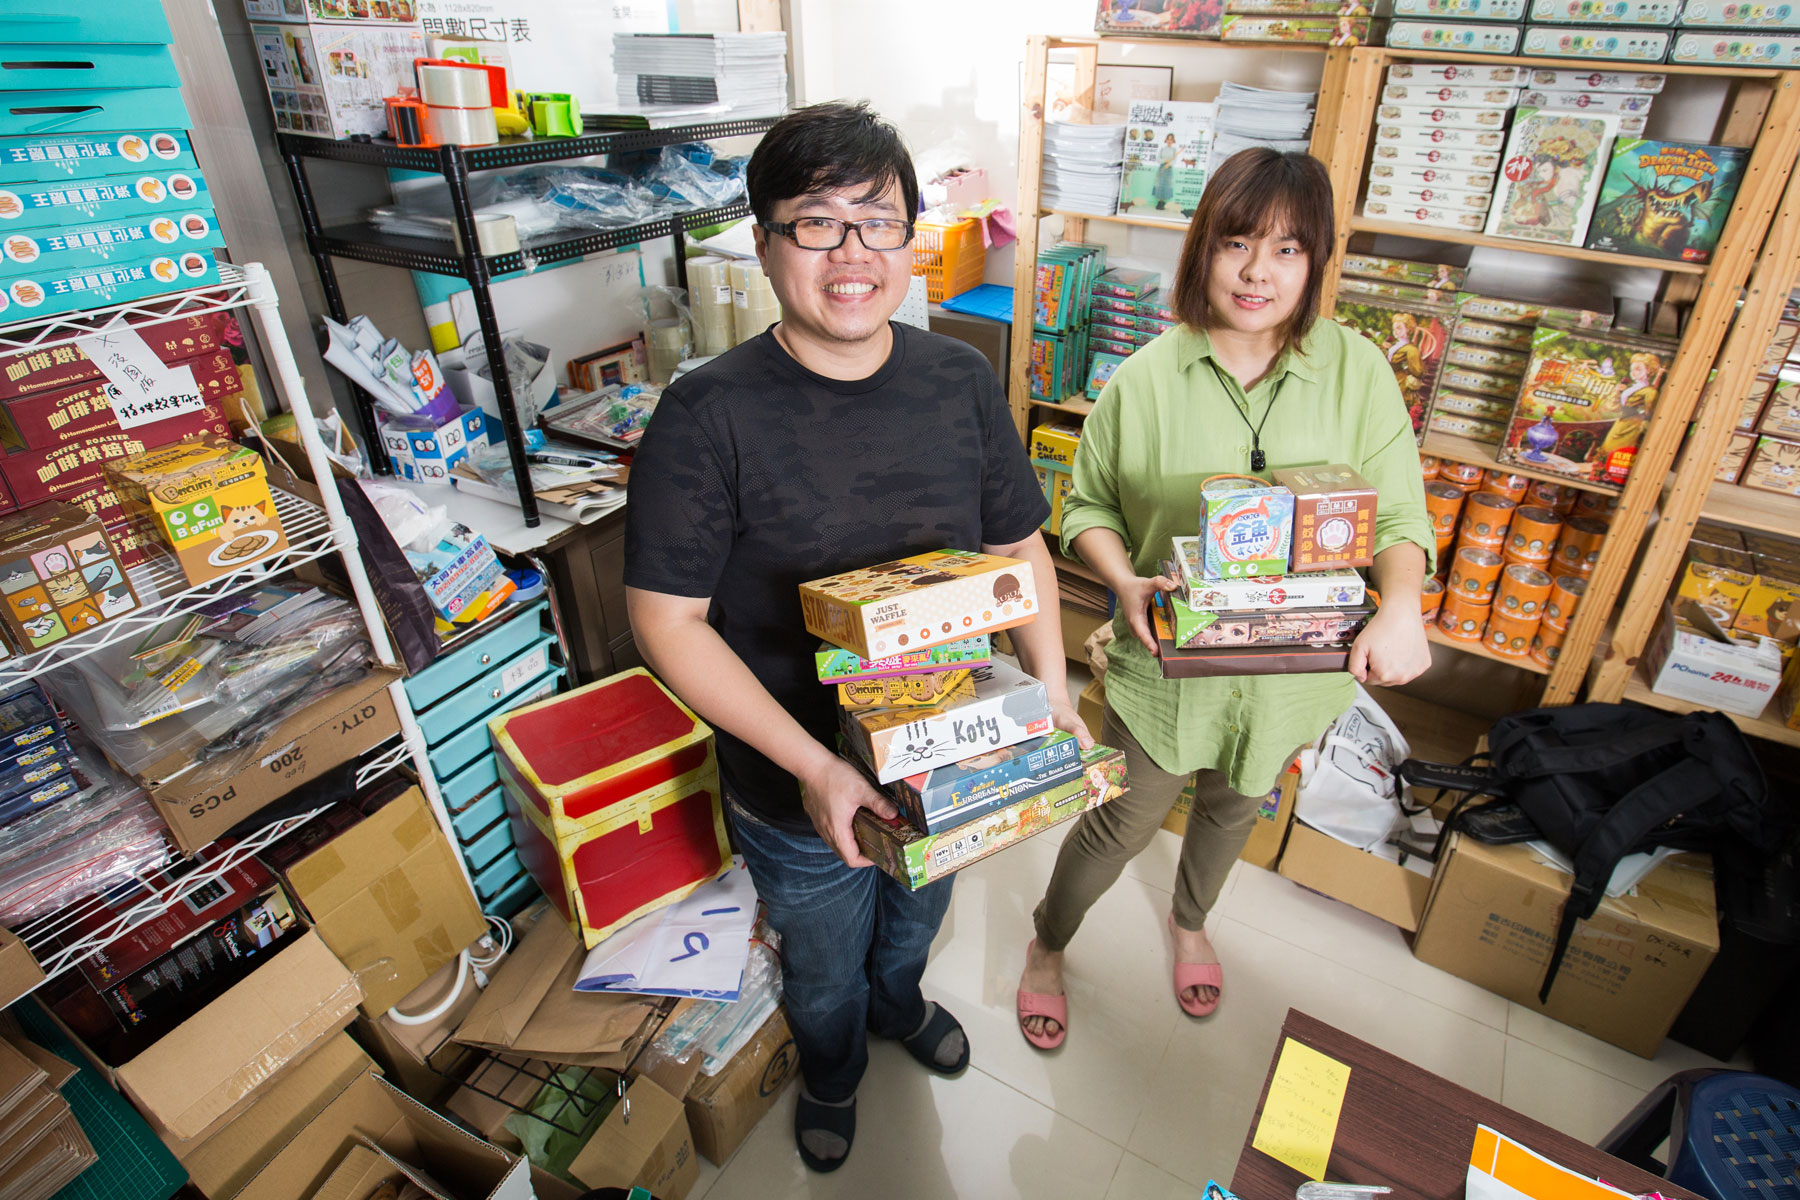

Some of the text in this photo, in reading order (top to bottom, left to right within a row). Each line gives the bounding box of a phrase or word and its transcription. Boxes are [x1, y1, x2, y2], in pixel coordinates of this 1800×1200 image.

[56, 389, 91, 407] COFFEE
[46, 434, 130, 461] COFFEE ROASTER
[1036, 441, 1055, 453] SAY
[1037, 451, 1068, 462] CHEESE
[1230, 519, 1269, 546] 金魚
[870, 608, 908, 625] WAFFLE
[876, 602, 899, 616] JUST
[1671, 662, 1711, 679] PChome
[952, 714, 1001, 746] Koty
[188, 704, 376, 820] QTY. 200 PCS
[998, 782, 1030, 799] UNION
